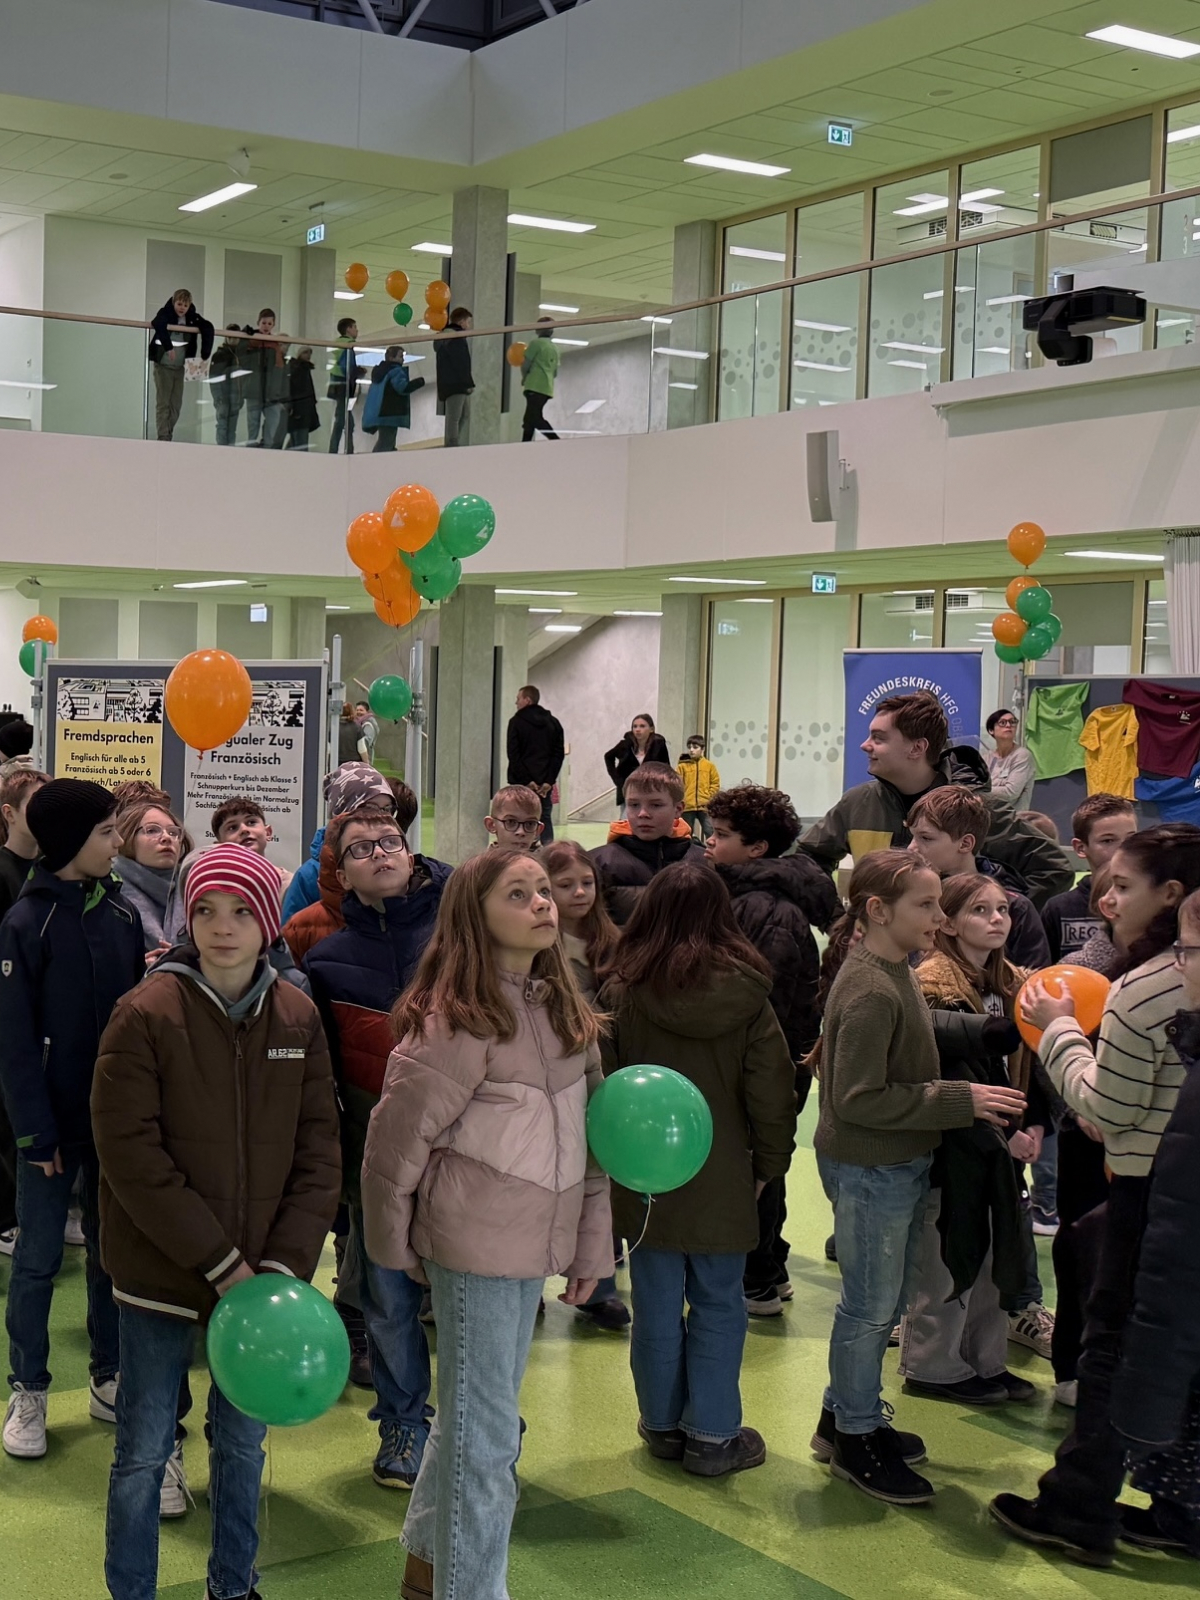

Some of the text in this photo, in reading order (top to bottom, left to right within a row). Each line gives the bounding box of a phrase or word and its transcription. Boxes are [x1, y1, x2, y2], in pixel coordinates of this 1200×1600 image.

[858, 676, 959, 715] FREUNDESKREIS HFG
[63, 728, 154, 746] Fremdsprachen
[225, 733, 294, 750] gualer Zug
[70, 752, 146, 764] Englisch für alle ab 5
[210, 751, 281, 765] Französisch
[65, 764, 152, 776] Französisch ab 5 oder 6
[190, 772, 227, 781] Französisch
[233, 774, 259, 783] Englisch
[260, 775, 269, 783] ab
[270, 775, 291, 784] Klasse
[197, 782, 290, 793] Schnupperkurs bis Dezember
[187, 791, 204, 799] Mehr
[263, 796, 300, 806] Normalzug
